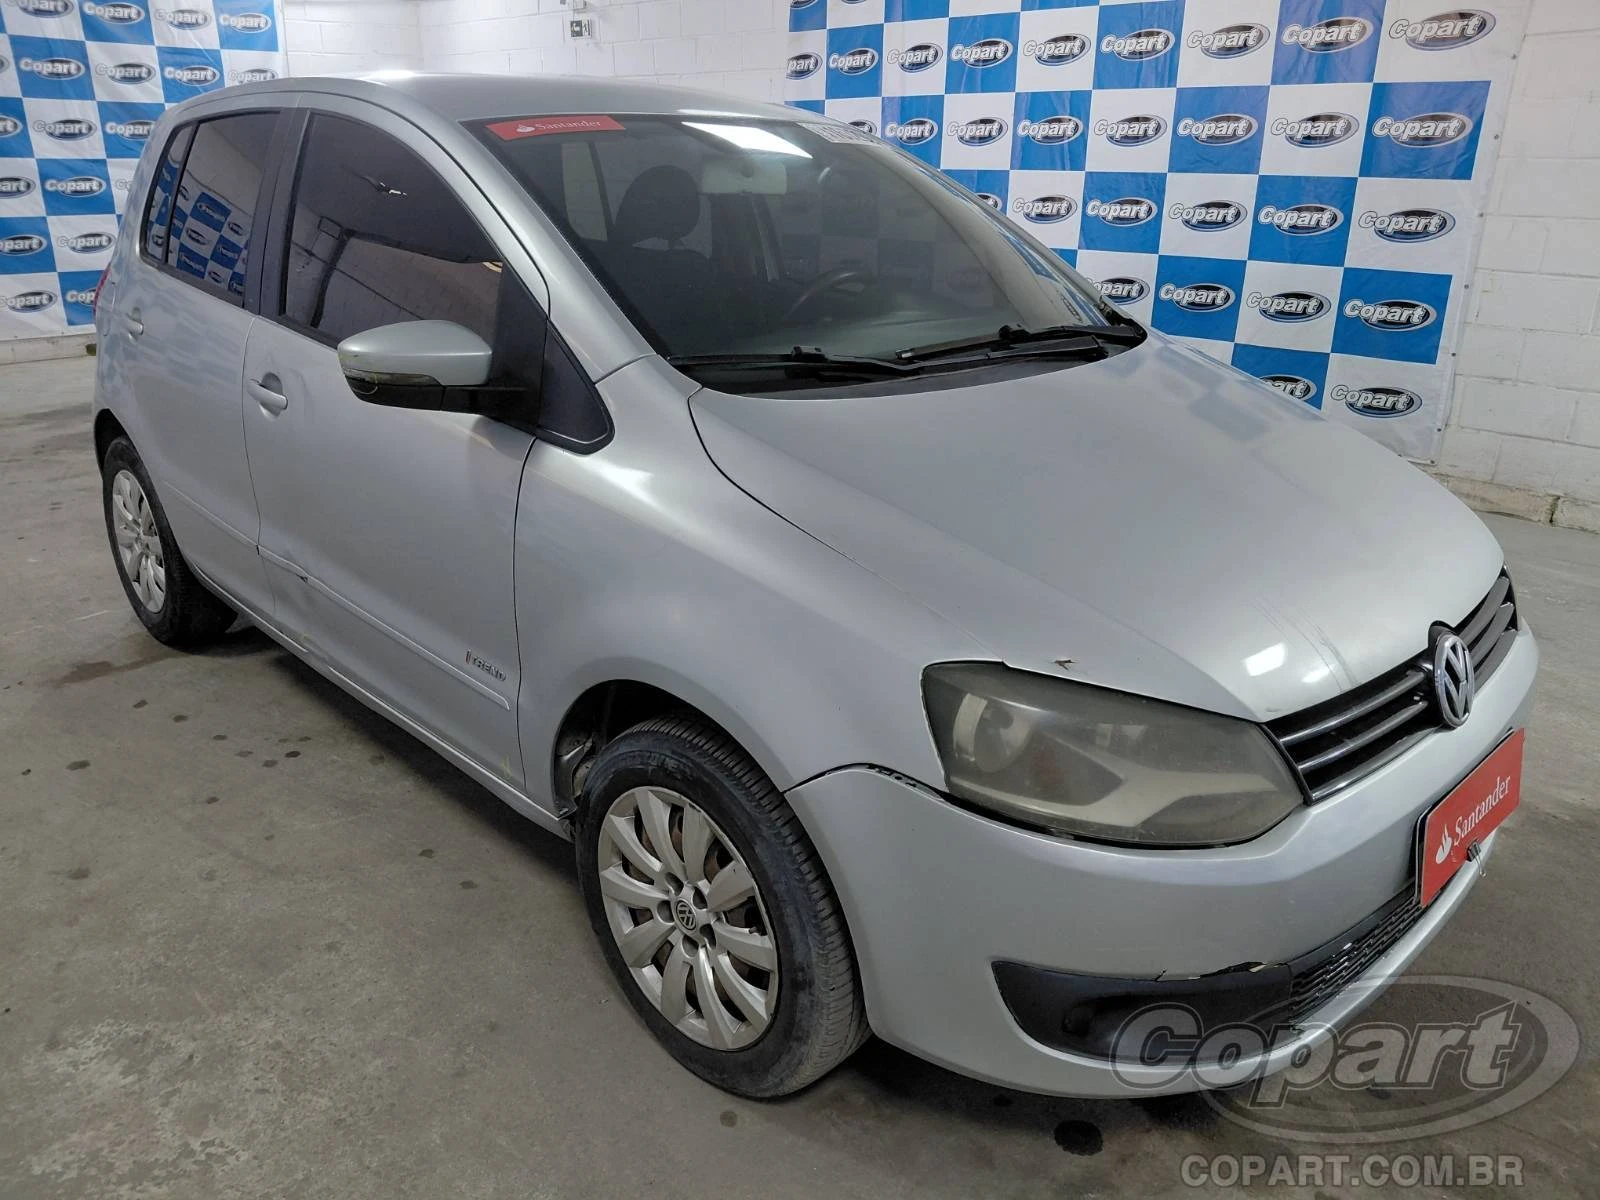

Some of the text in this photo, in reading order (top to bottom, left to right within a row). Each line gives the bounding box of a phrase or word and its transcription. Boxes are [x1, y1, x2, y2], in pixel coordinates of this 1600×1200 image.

[84, 3, 138, 20] Copart
[155, 9, 207, 26] Copart
[219, 14, 267, 29] Copart
[1187, 25, 1263, 54] Copart
[1281, 19, 1363, 49] Copart
[1389, 13, 1483, 44] Copart
[951, 43, 1005, 64] Copart
[1023, 37, 1082, 61] Copart
[1100, 32, 1166, 58] Copart
[19, 58, 78, 76] Copart
[788, 57, 815, 73] part
[829, 51, 873, 71] Copart
[887, 46, 937, 69] Copart
[97, 63, 152, 80] Copart
[164, 66, 213, 82] Copart
[34, 119, 91, 136] Copart
[105, 121, 153, 137] Copar
[535, 120, 601, 130] Santander
[886, 121, 933, 140] Copart
[947, 121, 1002, 141] Copart
[1017, 119, 1076, 141] Copart
[1094, 117, 1158, 142] Copart
[1176, 116, 1250, 142] Copart
[1270, 116, 1350, 142] Copart
[1371, 115, 1462, 143] Copart
[45, 179, 101, 194] Copart
[1012, 197, 1069, 218] Copart
[1086, 199, 1150, 222] Copart
[1168, 202, 1238, 228] Copart
[1257, 205, 1333, 231] Copart
[1358, 207, 1446, 237] Copart
[57, 236, 110, 253] Copart
[1159, 283, 1228, 308] Copart
[1246, 292, 1322, 317] Copart
[1343, 299, 1428, 329] Copart
[1331, 385, 1411, 413] Copart
[1453, 775, 1511, 847] Santander
